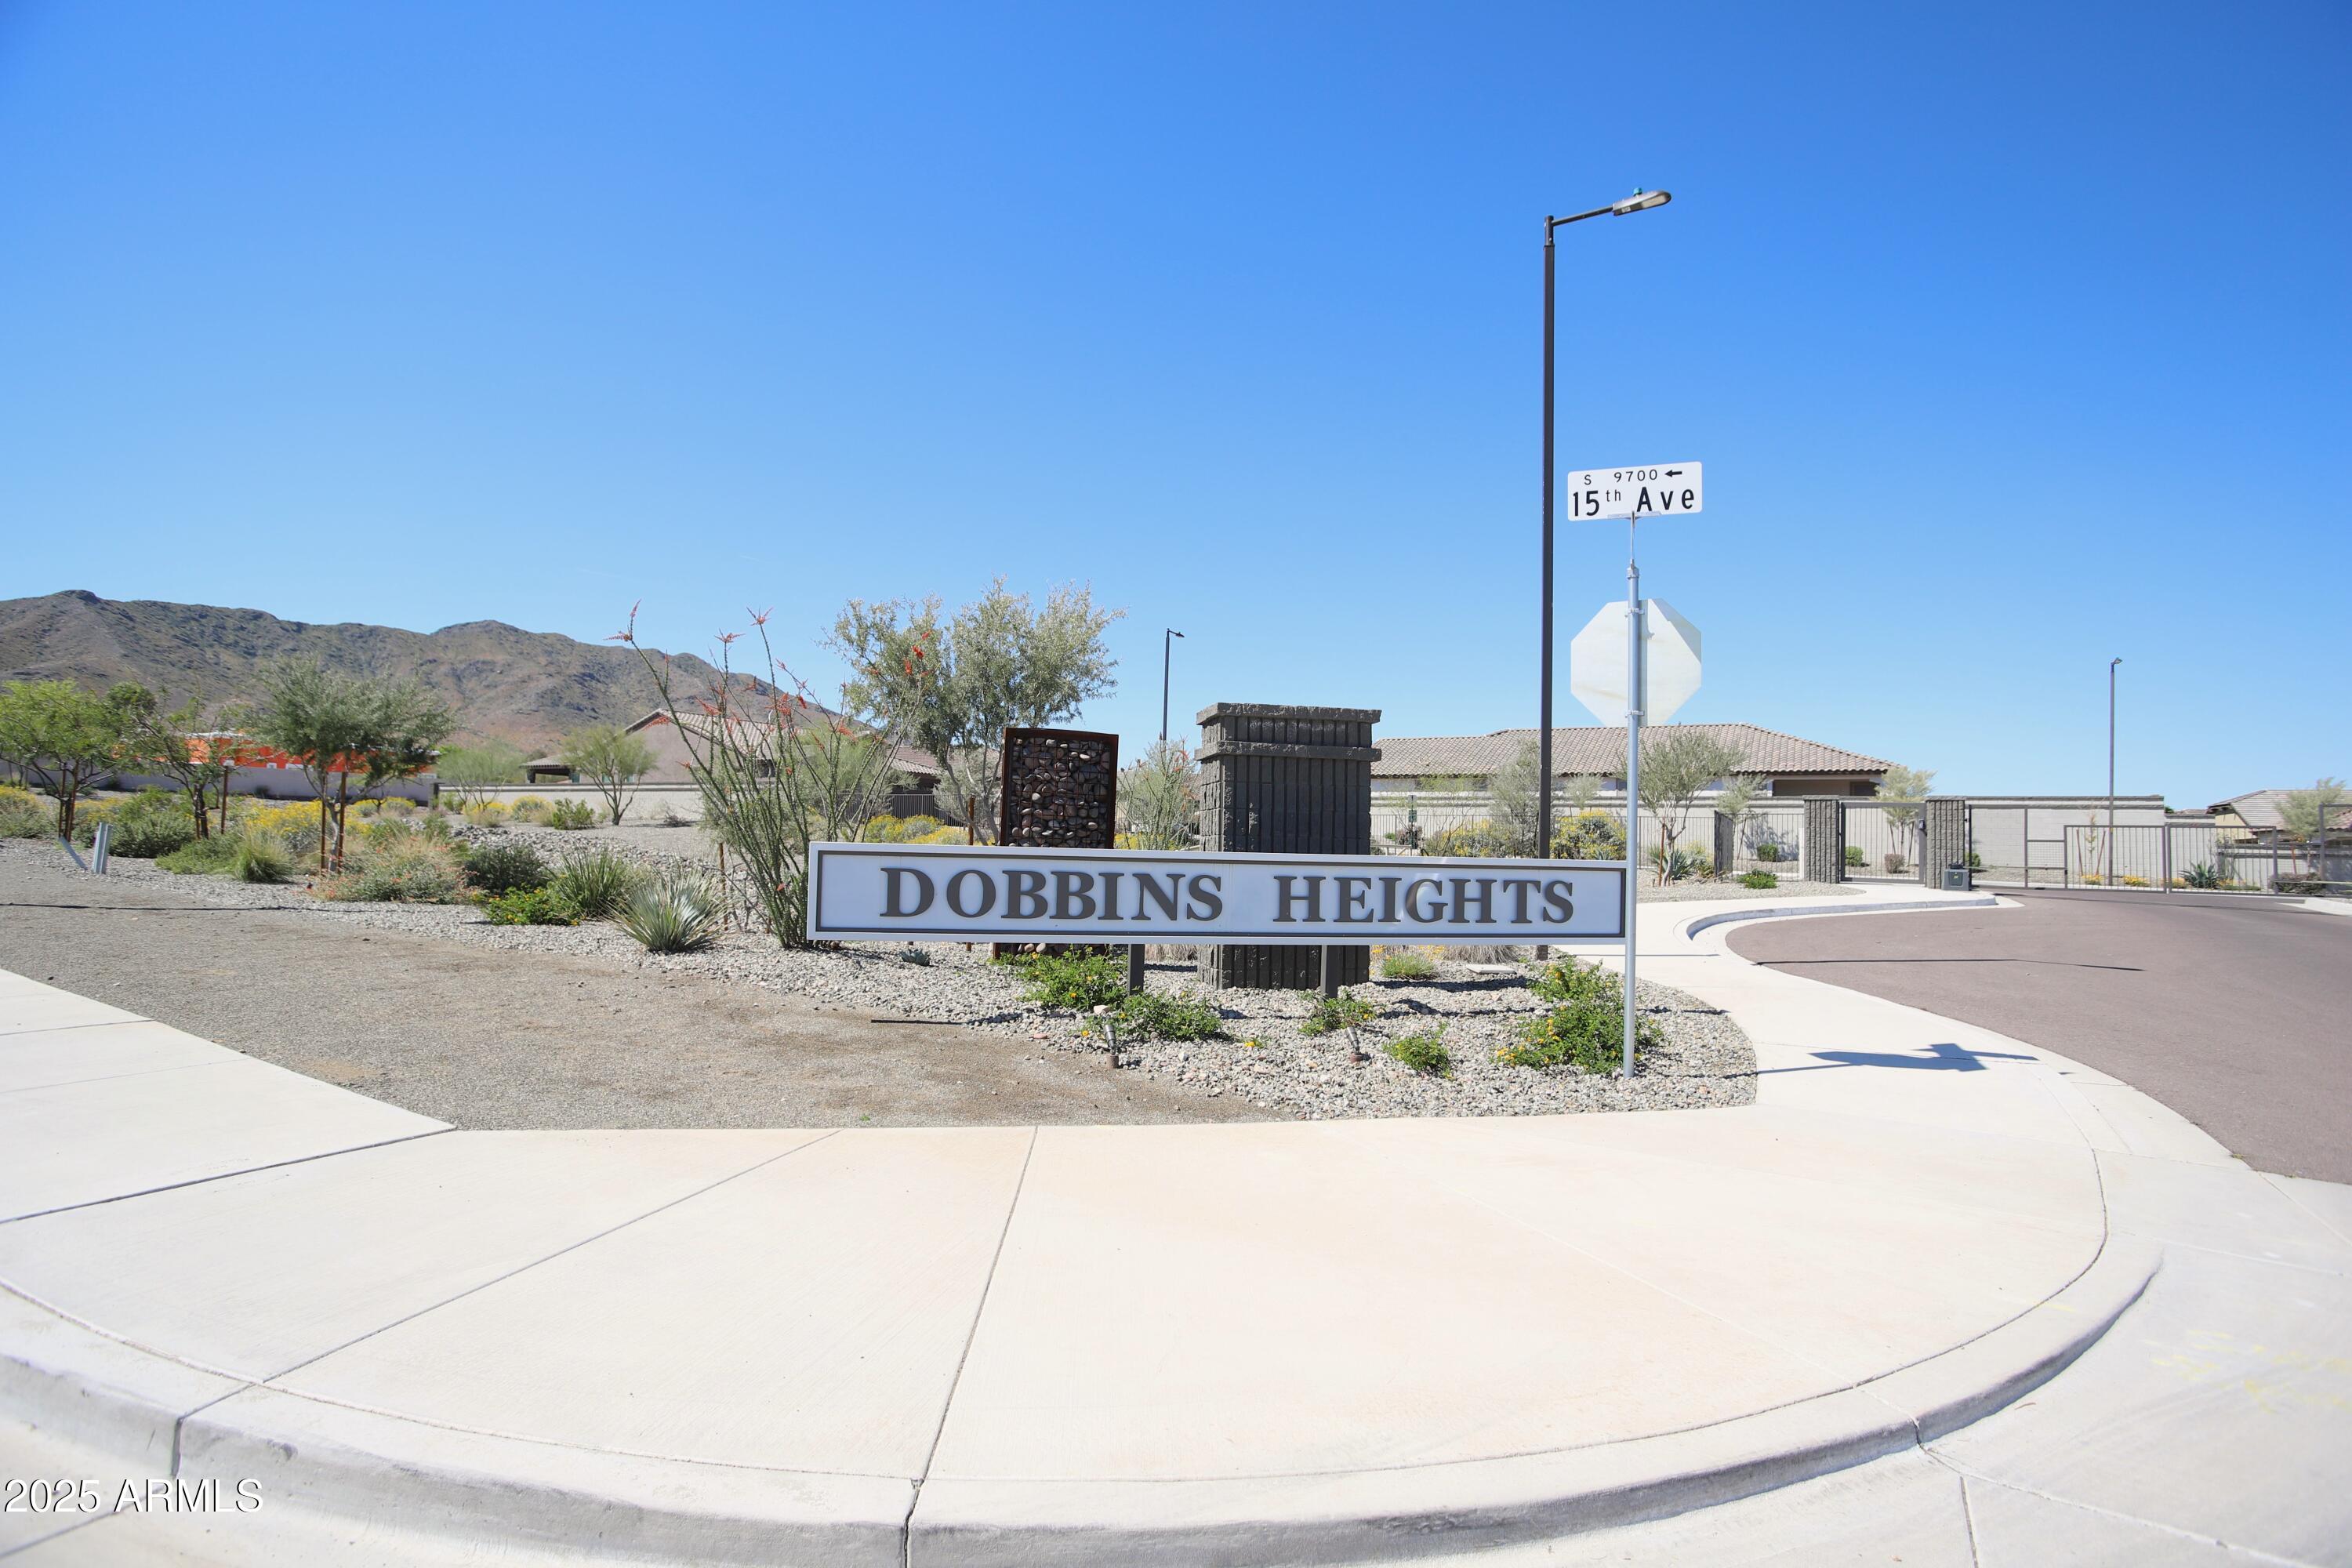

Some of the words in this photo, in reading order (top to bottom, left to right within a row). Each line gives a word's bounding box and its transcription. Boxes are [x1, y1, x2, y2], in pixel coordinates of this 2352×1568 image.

[1584, 474, 1592, 485] S
[1613, 469, 1658, 483] 9700
[1573, 489, 1621, 517] 15th
[1636, 486, 1694, 512] Ave
[879, 867, 1223, 922] DOBBINS
[1272, 875, 1574, 924] HEIGHTS
